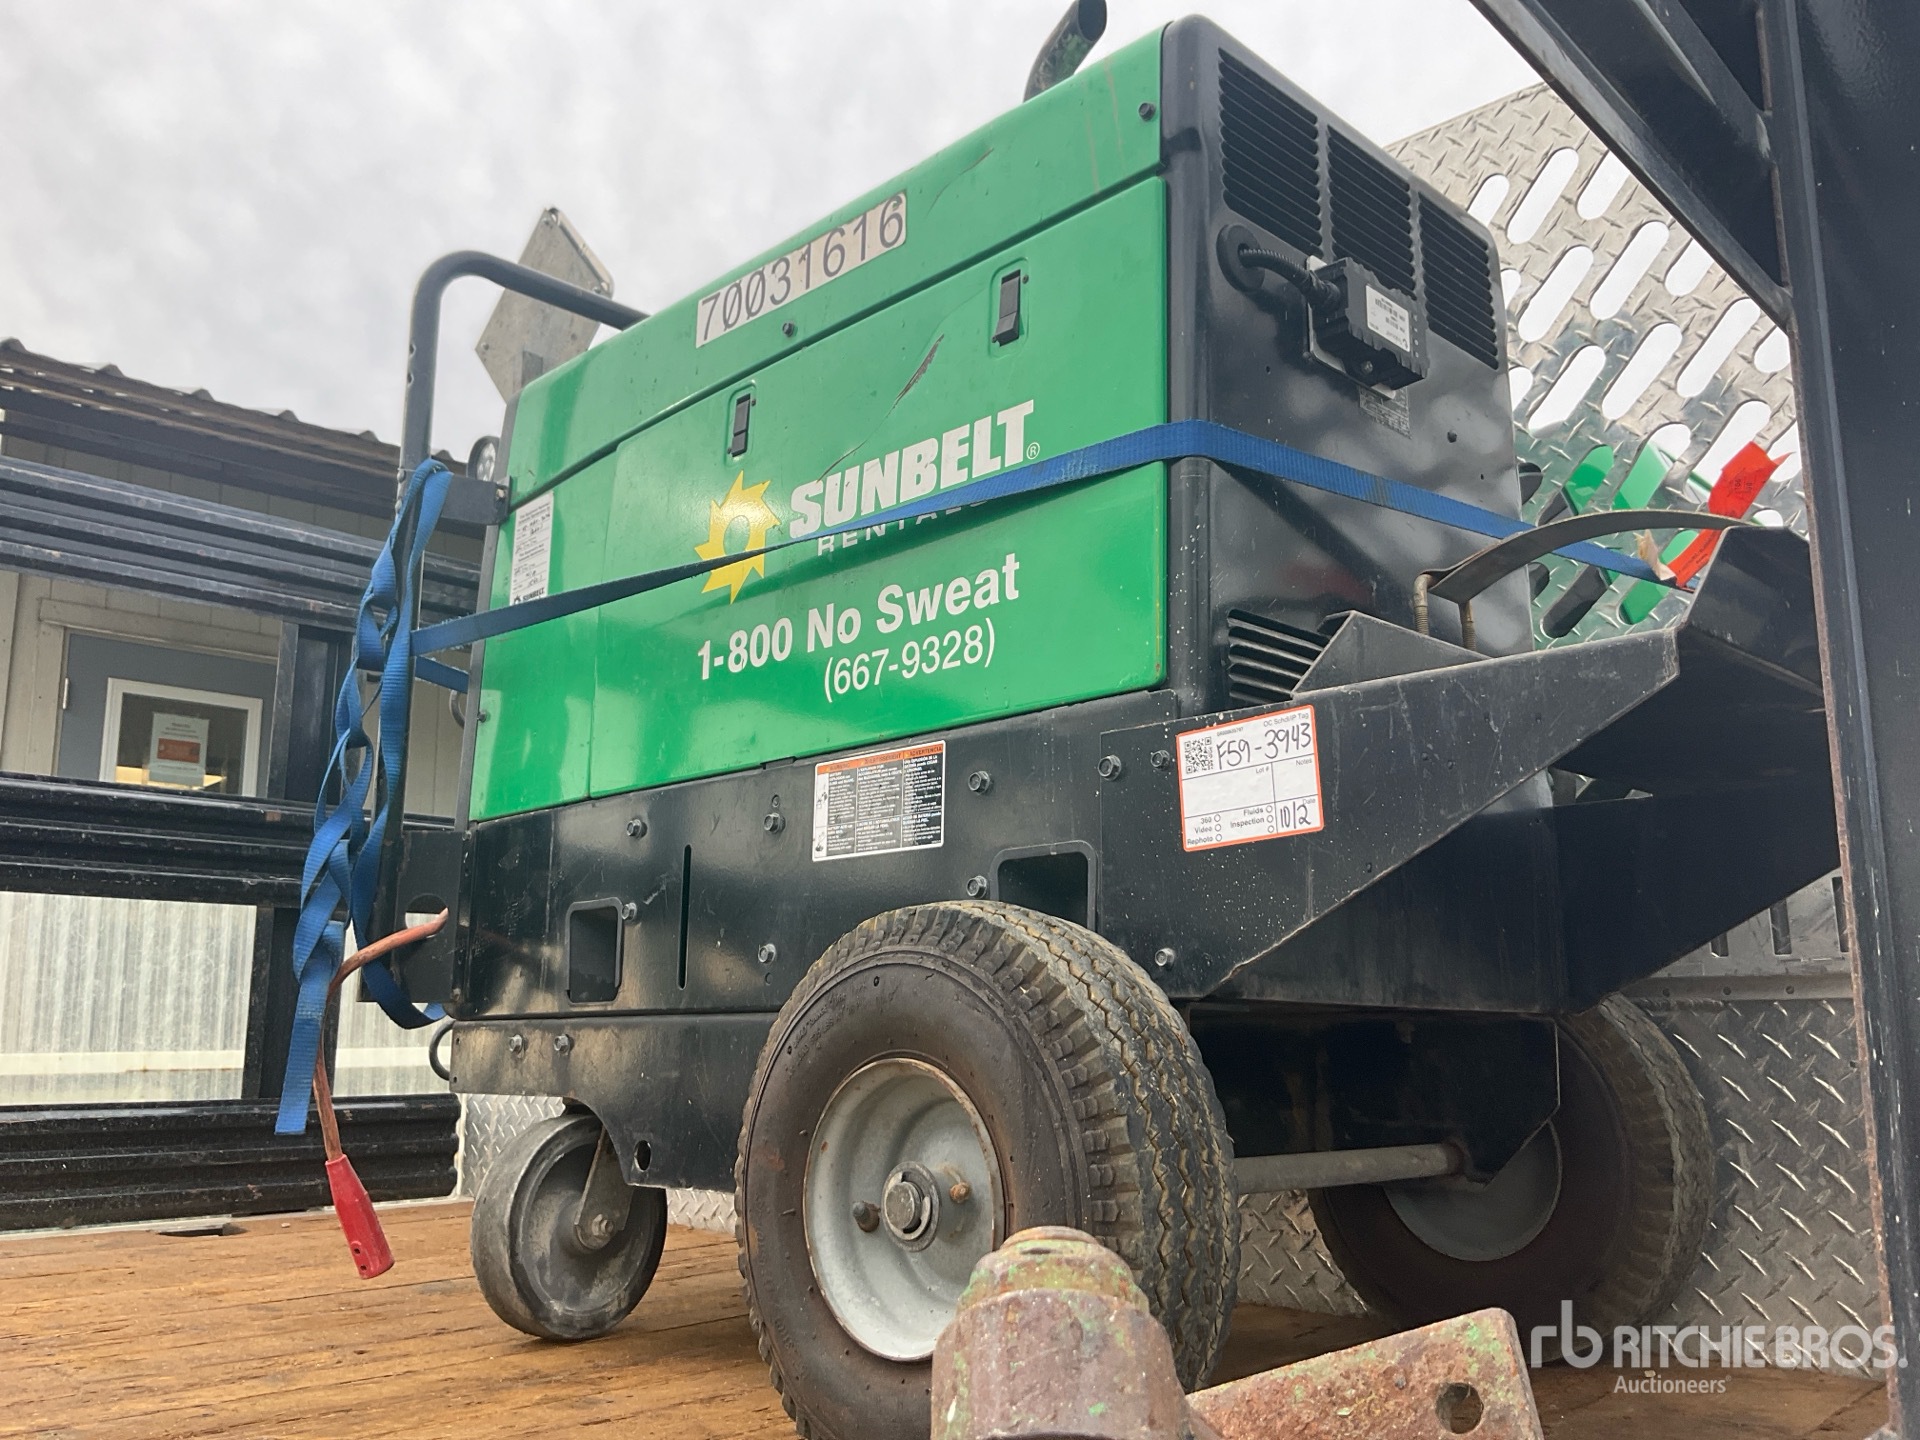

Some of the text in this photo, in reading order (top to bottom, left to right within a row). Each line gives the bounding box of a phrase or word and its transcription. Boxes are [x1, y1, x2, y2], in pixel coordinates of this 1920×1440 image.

[700, 194, 905, 342] 70031616
[789, 399, 1035, 539] SUNBELT
[697, 553, 1020, 681] 1-800 No Sweat
[824, 618, 996, 704] (667-9328)
[1298, 712, 1310, 721] Tag
[1216, 723, 1312, 770] F59-3943
[1295, 758, 1313, 767] Notes
[1243, 807, 1264, 816] Fluids
[1279, 801, 1312, 830] 10/2
[1200, 816, 1212, 825] 360
[1230, 816, 1265, 828] Inspection
[1194, 825, 1213, 834] Video
[1187, 835, 1214, 846] Rephoto
